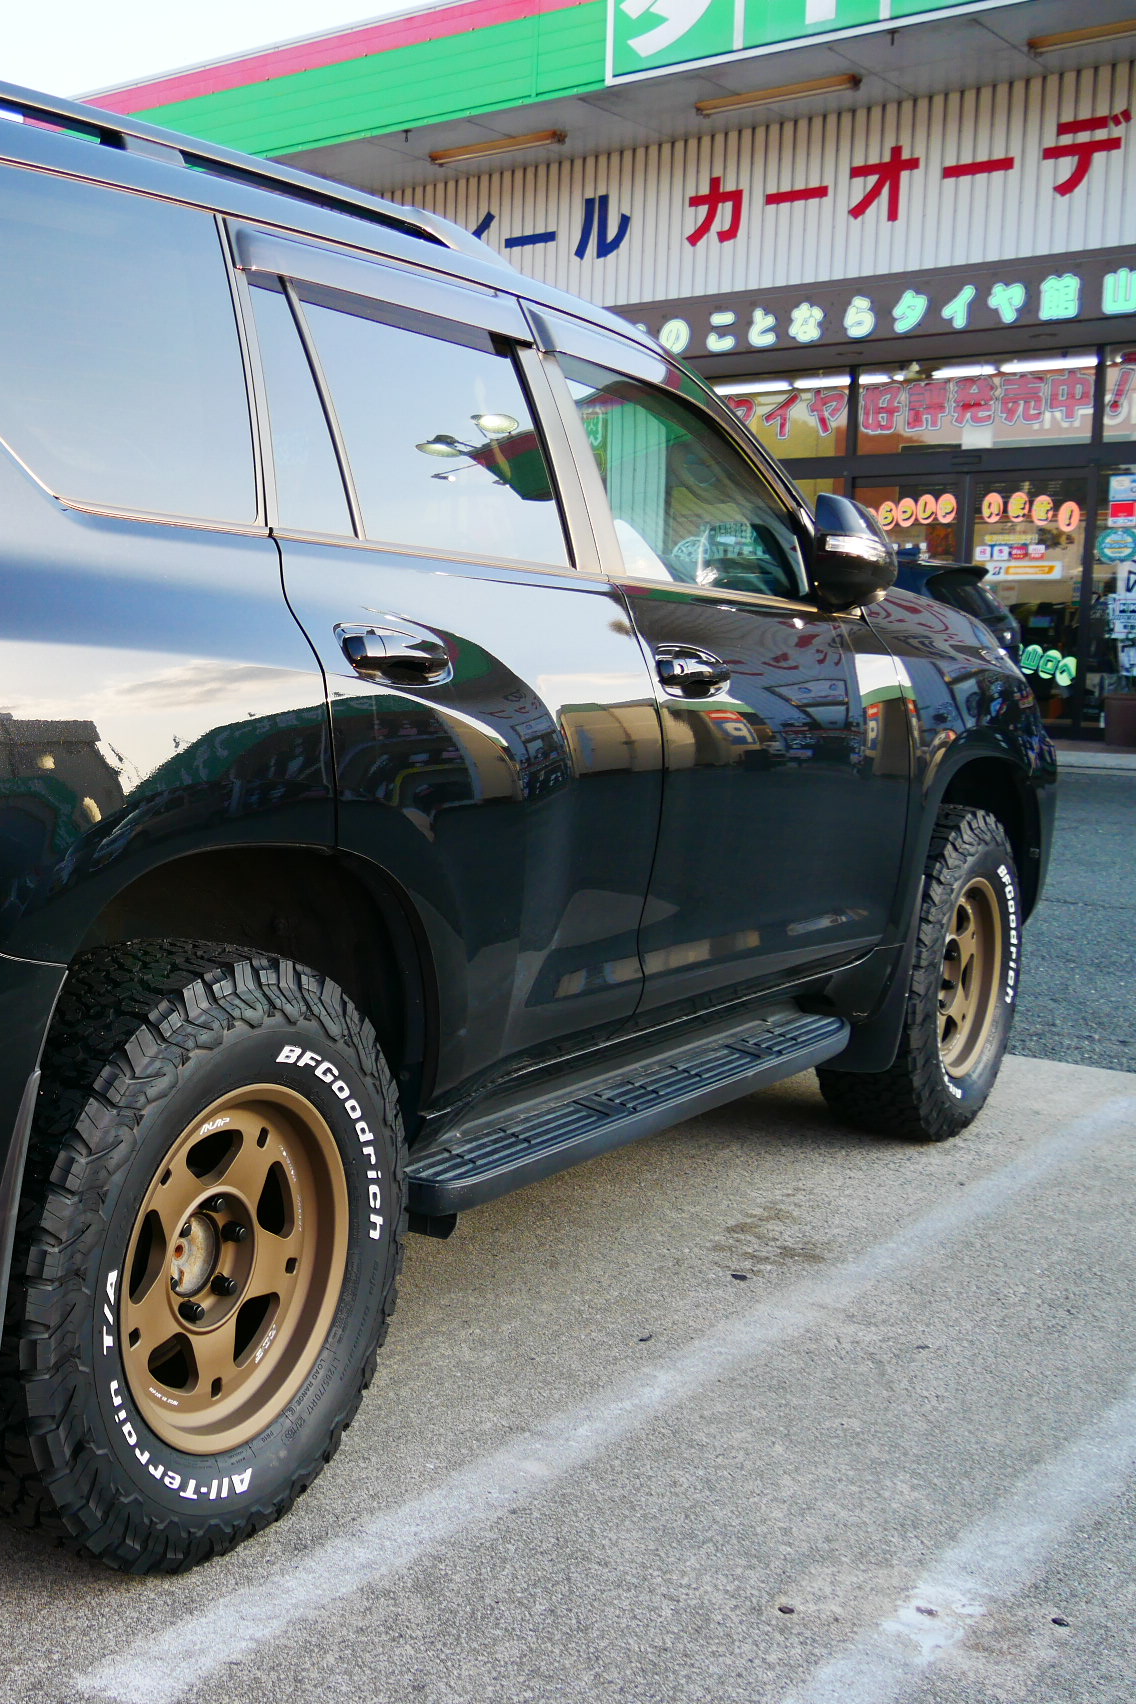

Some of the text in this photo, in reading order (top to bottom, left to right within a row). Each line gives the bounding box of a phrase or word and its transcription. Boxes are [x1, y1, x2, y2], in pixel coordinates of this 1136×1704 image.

[637, 267, 1136, 355] のことならタイヤ館山
[275, 1044, 383, 1240] BFGoodrich
[103, 1269, 252, 1500] All-Terrain T/A
